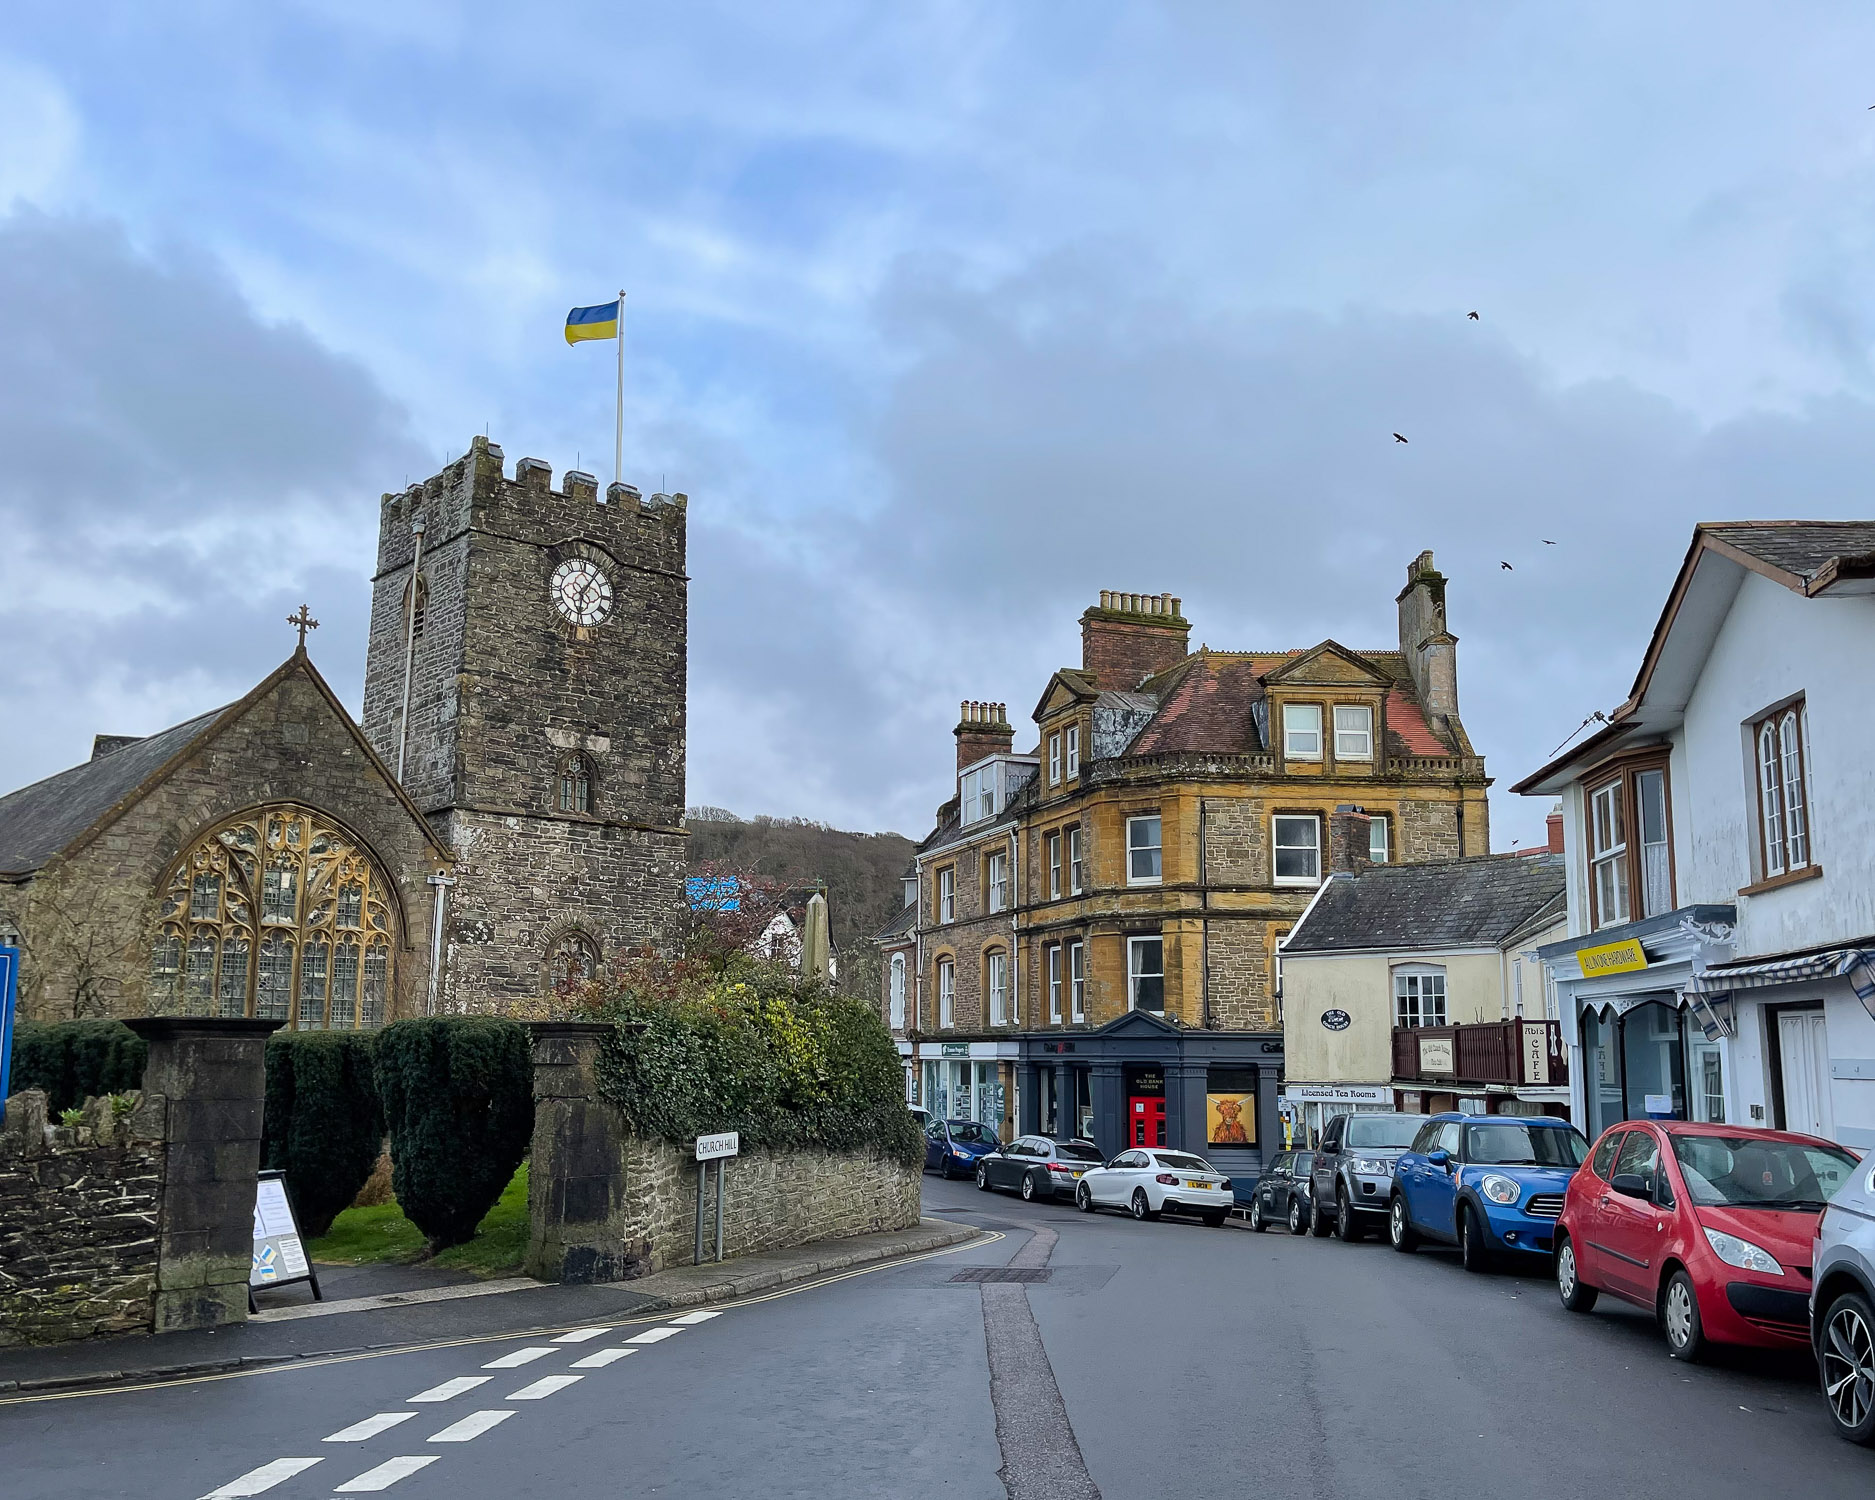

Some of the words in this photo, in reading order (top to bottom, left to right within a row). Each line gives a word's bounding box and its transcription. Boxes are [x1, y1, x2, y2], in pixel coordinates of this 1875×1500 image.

[1584, 956, 1594, 970] ALL
[1597, 953, 1610, 967] ONE
[1606, 948, 1638, 966] HARDWARE
[1301, 1089, 1333, 1097] Licensed
[1334, 1090, 1349, 1098] Tea
[1350, 1090, 1376, 1098] Rooms
[698, 1140, 724, 1154] CHURCH
[724, 1138, 737, 1150] HILL
